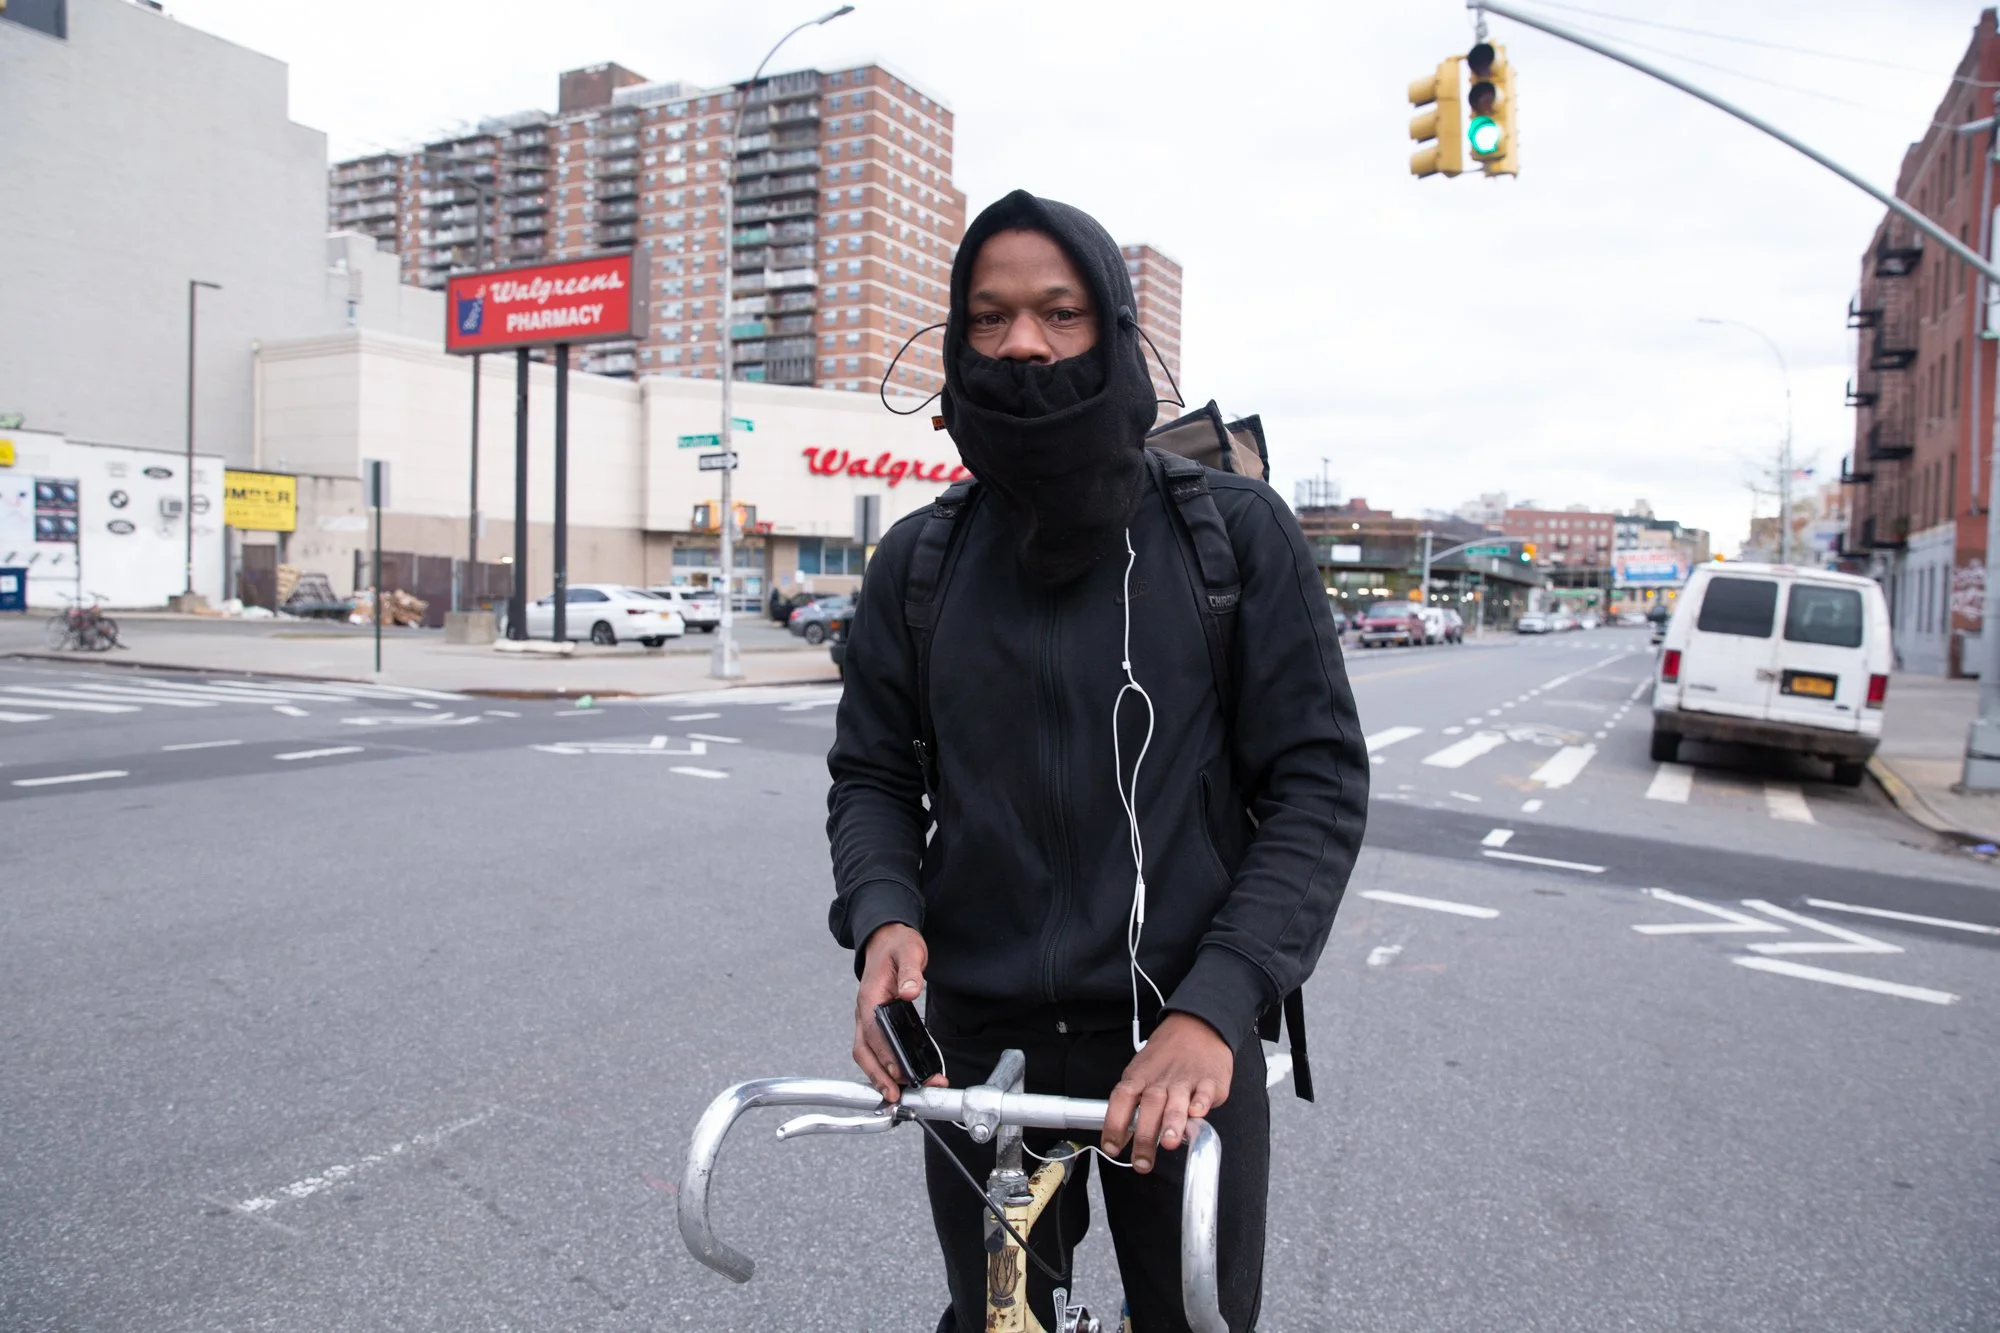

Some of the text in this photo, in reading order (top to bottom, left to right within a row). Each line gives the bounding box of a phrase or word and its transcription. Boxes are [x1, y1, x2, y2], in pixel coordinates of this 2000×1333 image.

[490, 271, 624, 304] Walgreens
[506, 303, 603, 332] PHARMACY
[802, 447, 974, 488] Walgree
[1208, 592, 1241, 608] CHROM
